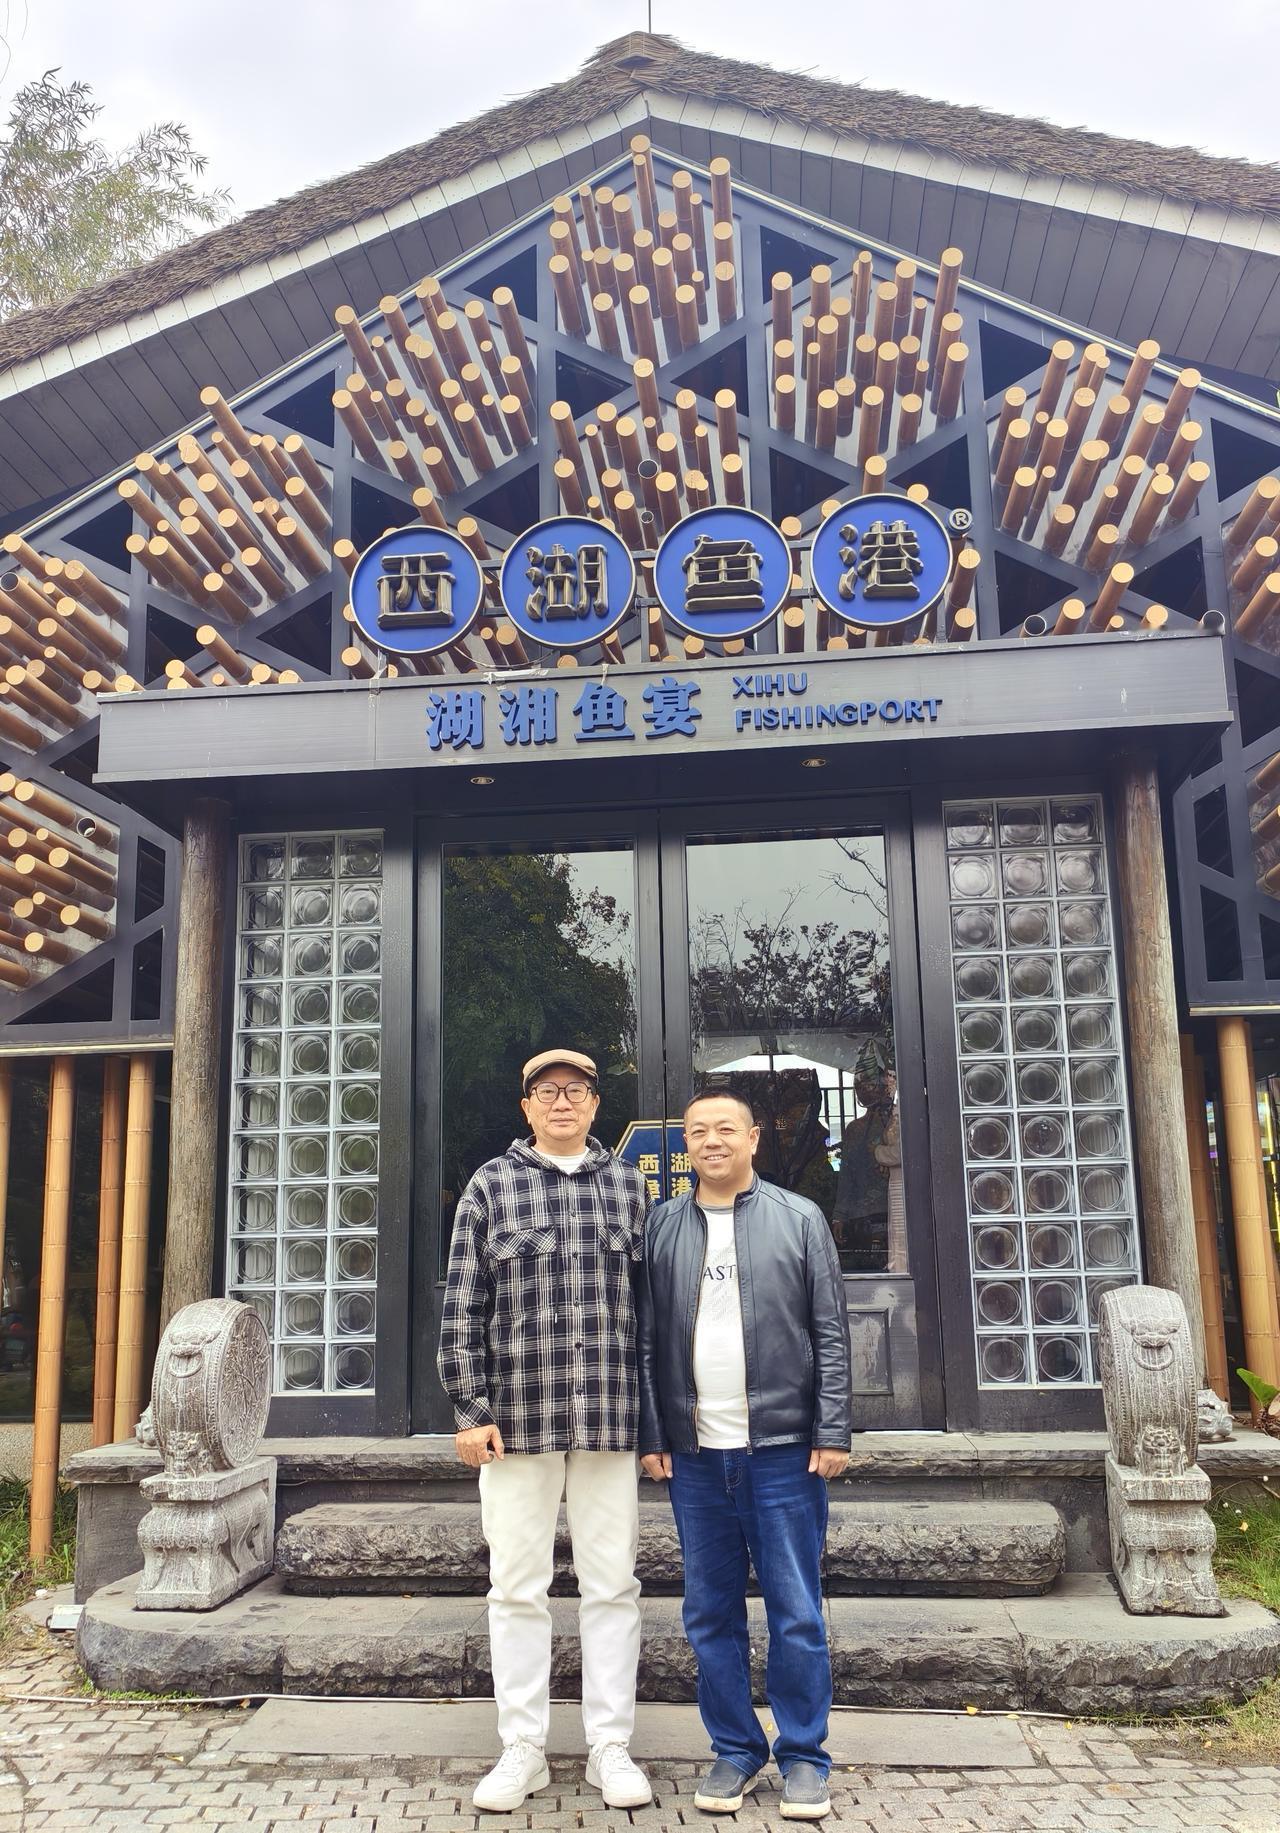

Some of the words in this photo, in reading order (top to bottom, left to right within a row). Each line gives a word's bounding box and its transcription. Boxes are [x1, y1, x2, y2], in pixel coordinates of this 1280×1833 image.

[376, 519, 926, 630] 西湖鱼港
[733, 673, 809, 699] XIHU
[426, 677, 702, 751] 湖湘鱼宴
[735, 698, 943, 732] FISHINGPORT
[639, 1152, 692, 1175] 西湖
